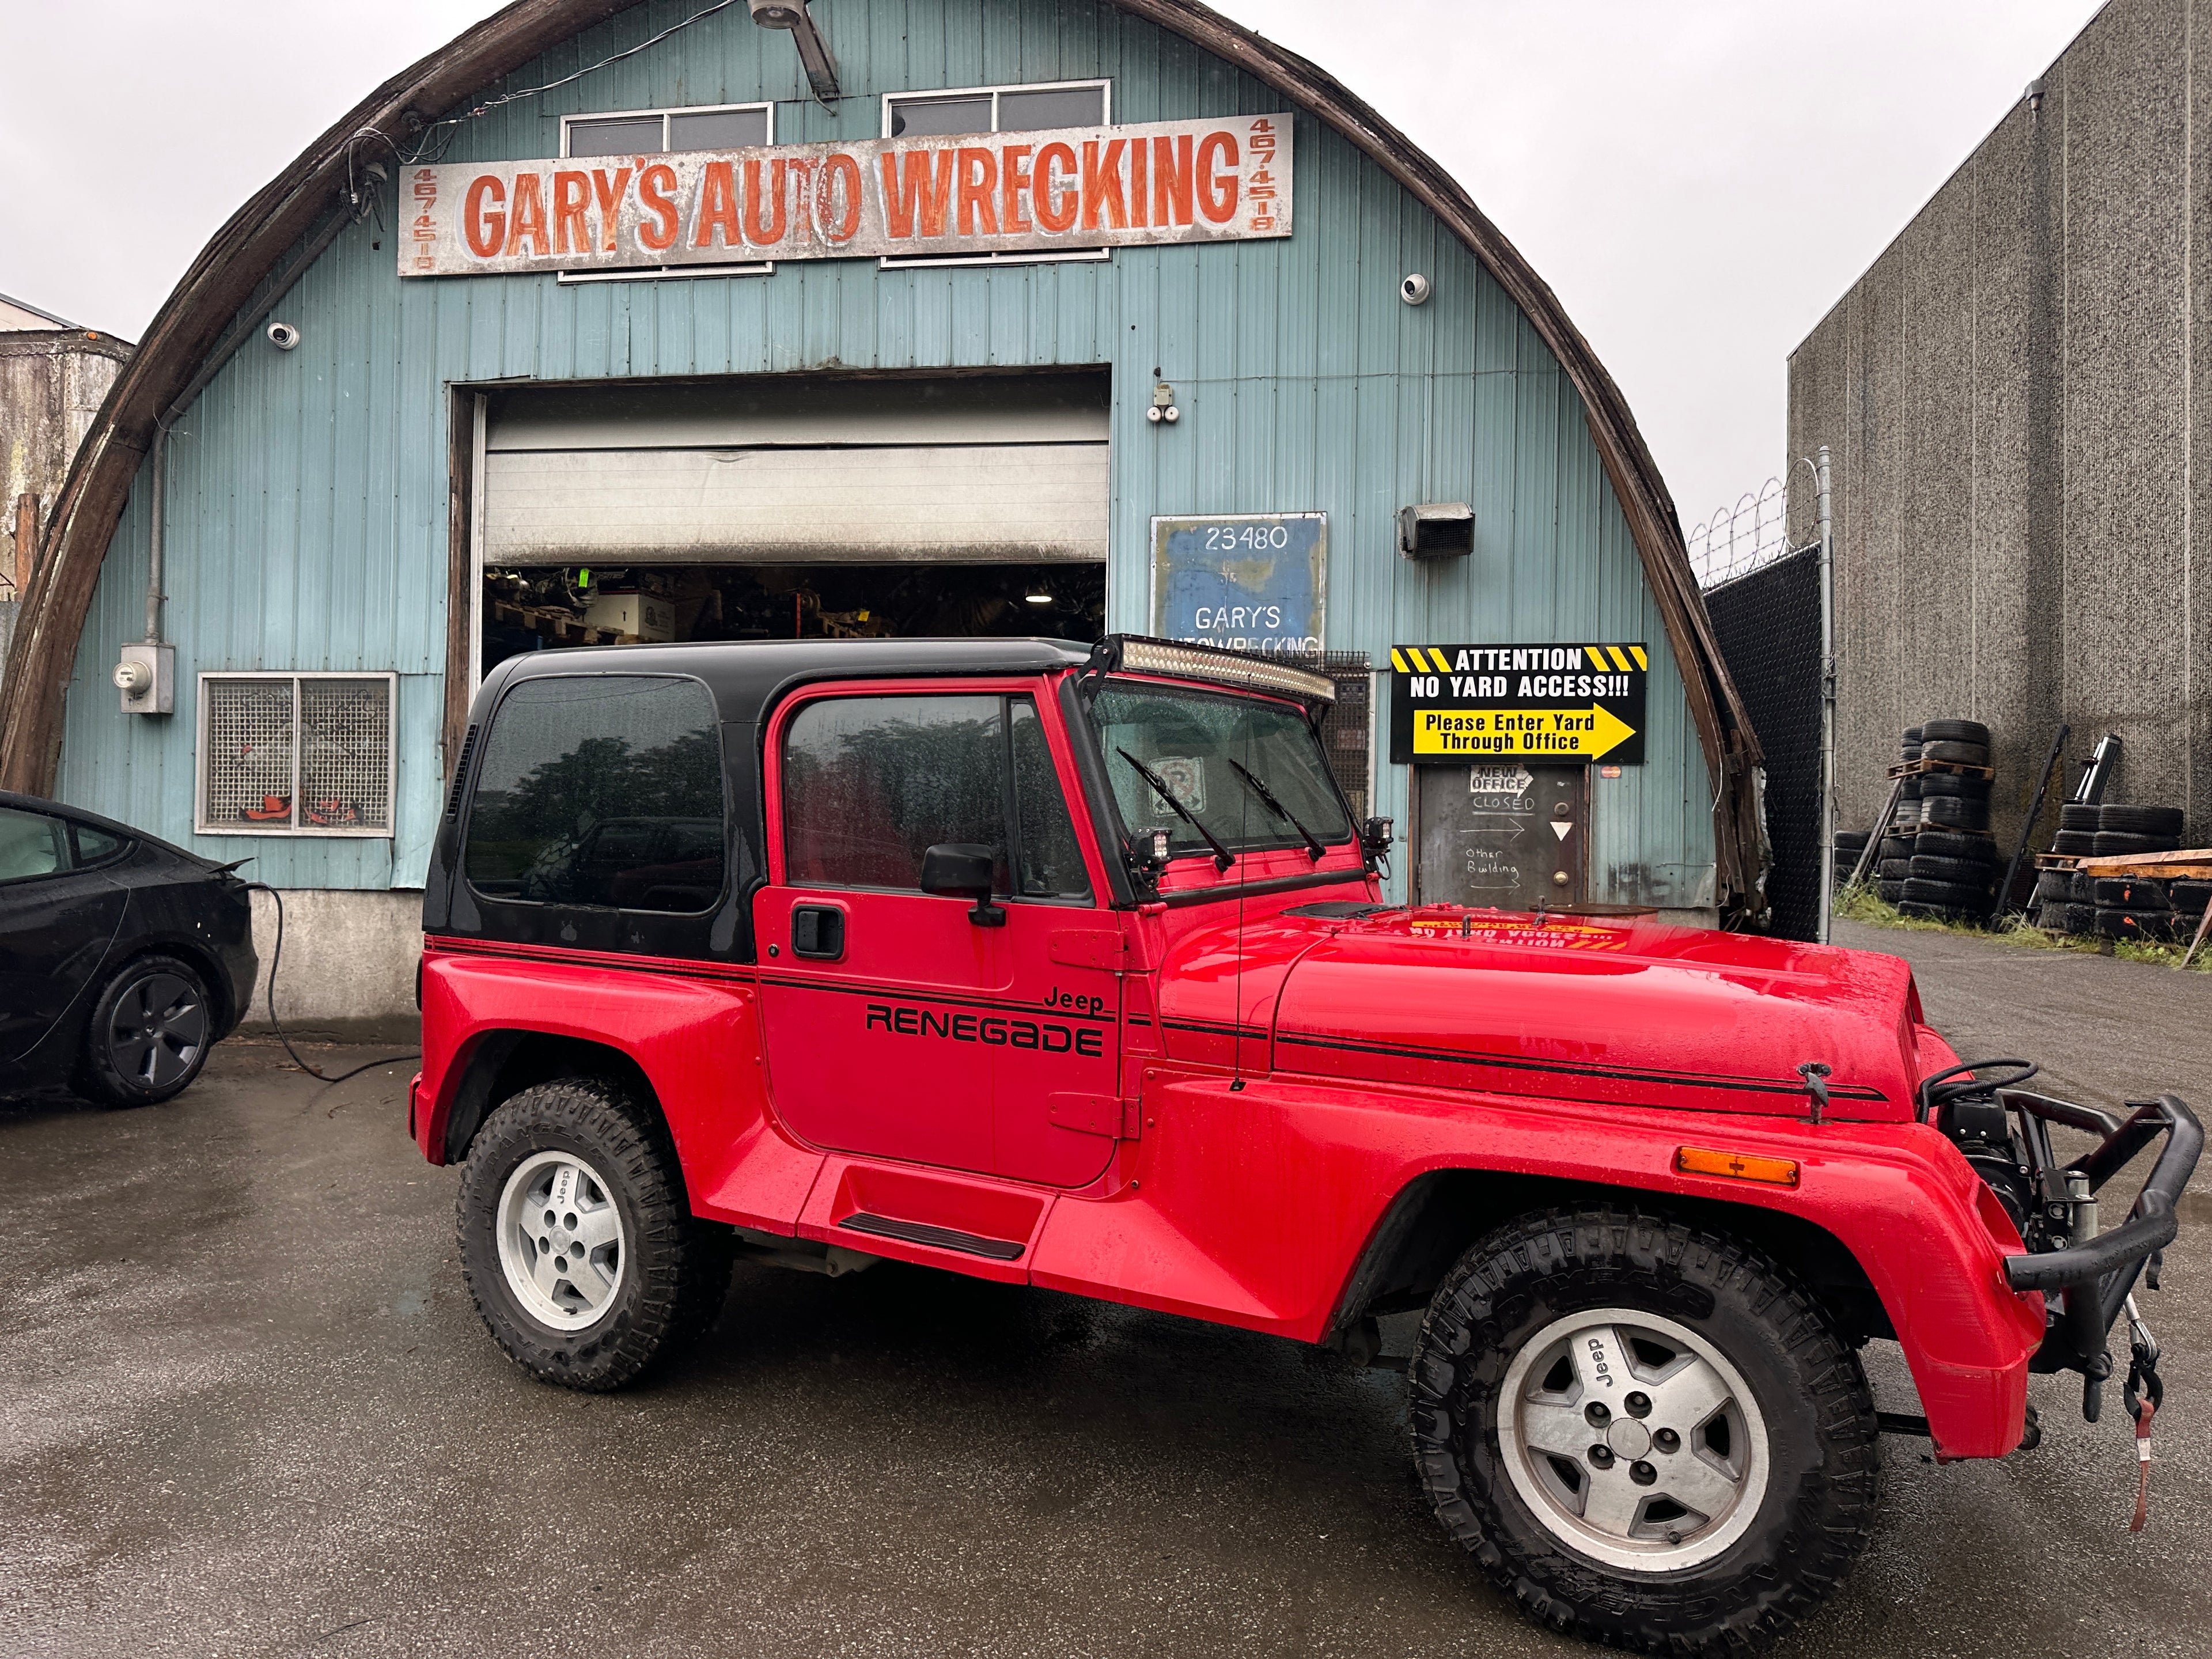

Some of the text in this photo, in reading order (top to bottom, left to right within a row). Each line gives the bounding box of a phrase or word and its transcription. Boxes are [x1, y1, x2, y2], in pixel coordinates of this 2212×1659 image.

[462, 131, 1240, 259] GARY'S AUTO WRECKING
[1205, 525, 1289, 550] 23480
[1195, 605, 1281, 629] GARY'S
[1455, 647, 1582, 671] ATTENTION
[1410, 675, 1629, 698] NO YARD ACCESS!!!
[1425, 713, 1594, 731] Please Enter Yard
[1440, 732, 1580, 753] Through Office
[1479, 766, 1518, 778] NEW
[1471, 778, 1527, 790] OFFICE
[1472, 796, 1535, 810] CLOSED
[1467, 860, 1519, 880] Building
[1043, 986, 1104, 1016] Jeep
[556, 1170, 570, 1205] Jeep
[1588, 1338, 1613, 1388] Jeep
